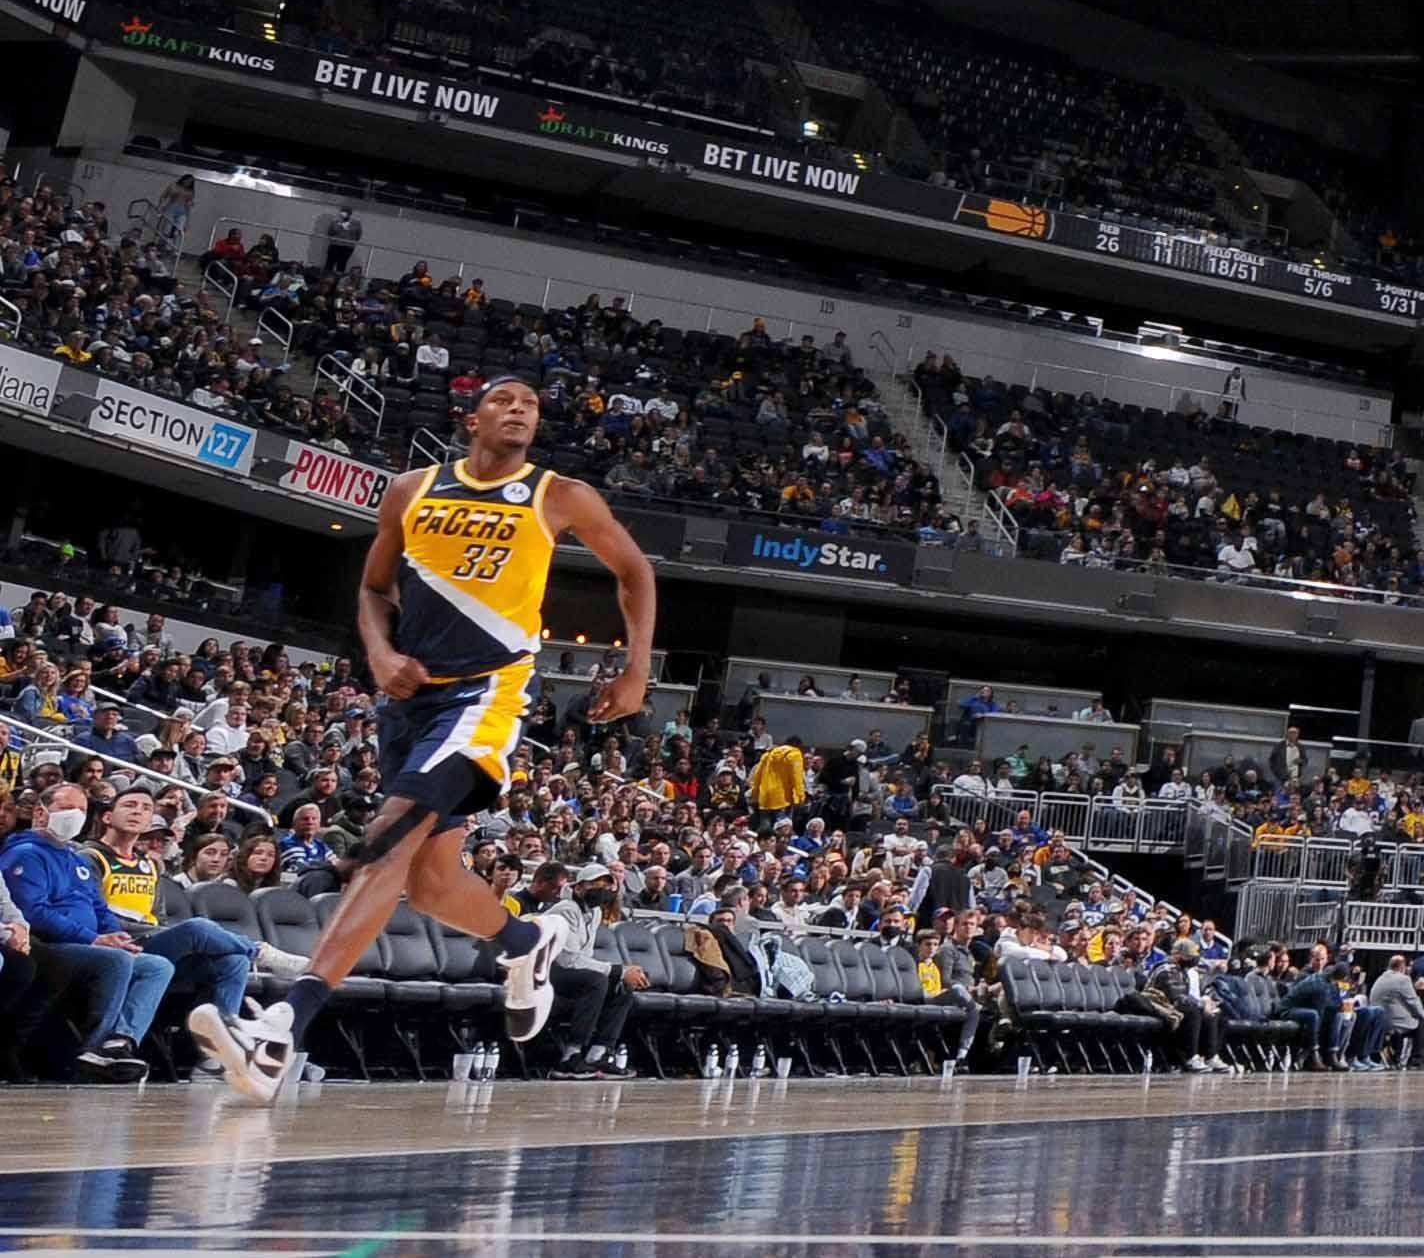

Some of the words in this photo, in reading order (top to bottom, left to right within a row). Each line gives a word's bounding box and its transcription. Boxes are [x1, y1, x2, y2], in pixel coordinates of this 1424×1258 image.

[315, 59, 367, 91] BET
[371, 72, 427, 105] LIVE
[434, 83, 500, 119] NOW
[704, 143, 747, 171] BET
[751, 153, 801, 183] LIVE
[805, 164, 860, 196] NOW
[1096, 235, 1120, 252] 26
[1099, 223, 1120, 236] REB
[1208, 258, 1257, 282] 18/51
[1234, 252, 1265, 266] GOALS
[1287, 264, 1311, 277] FREE
[1313, 269, 1351, 286] THROWS
[1304, 278, 1333, 297] 5/6
[1380, 294, 1417, 315] 9/31
[0, 364, 50, 411] iana
[99, 395, 205, 446] SECTION
[207, 429, 242, 460] 127
[290, 450, 392, 510] POINTSB
[412, 505, 523, 541] PACERS
[452, 543, 513, 583] 33
[752, 534, 888, 572] IndyStar.
